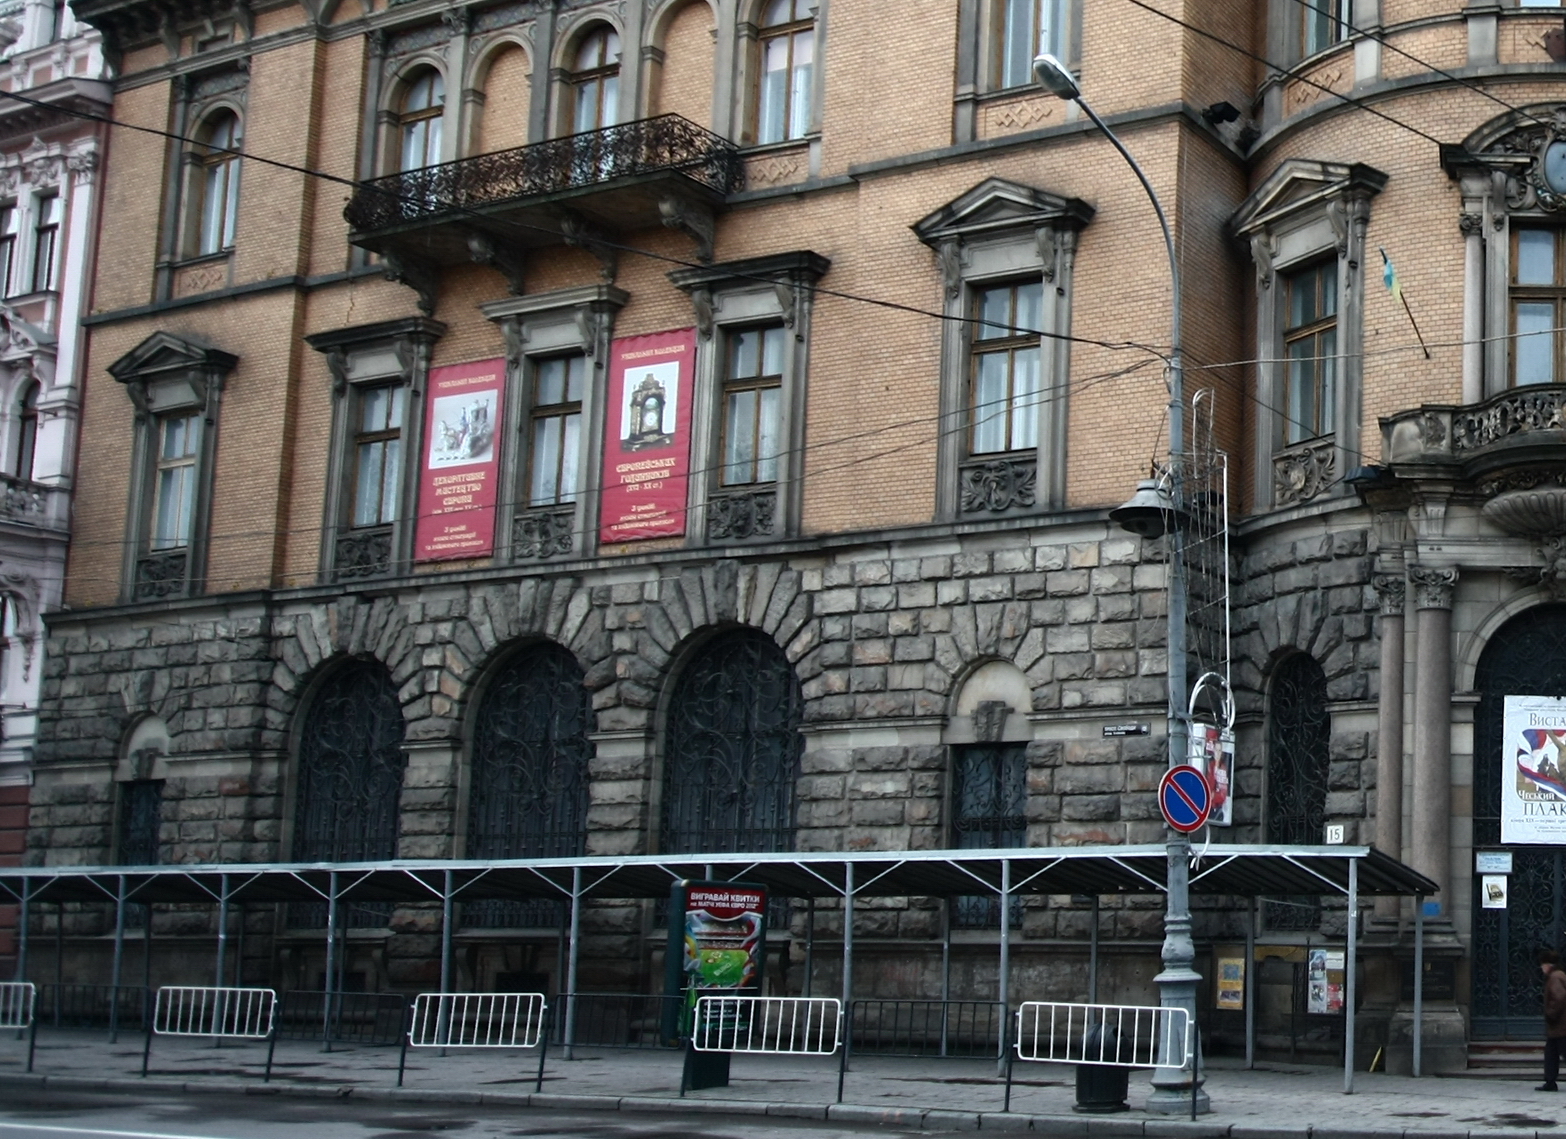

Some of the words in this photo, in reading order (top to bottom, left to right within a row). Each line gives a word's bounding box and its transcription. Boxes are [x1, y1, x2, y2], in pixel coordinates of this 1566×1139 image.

[1330, 829, 1340, 840] 15
[690, 892, 730, 902] ВИГРАВАЙ
[730, 894, 761, 904] КВИТКИ
